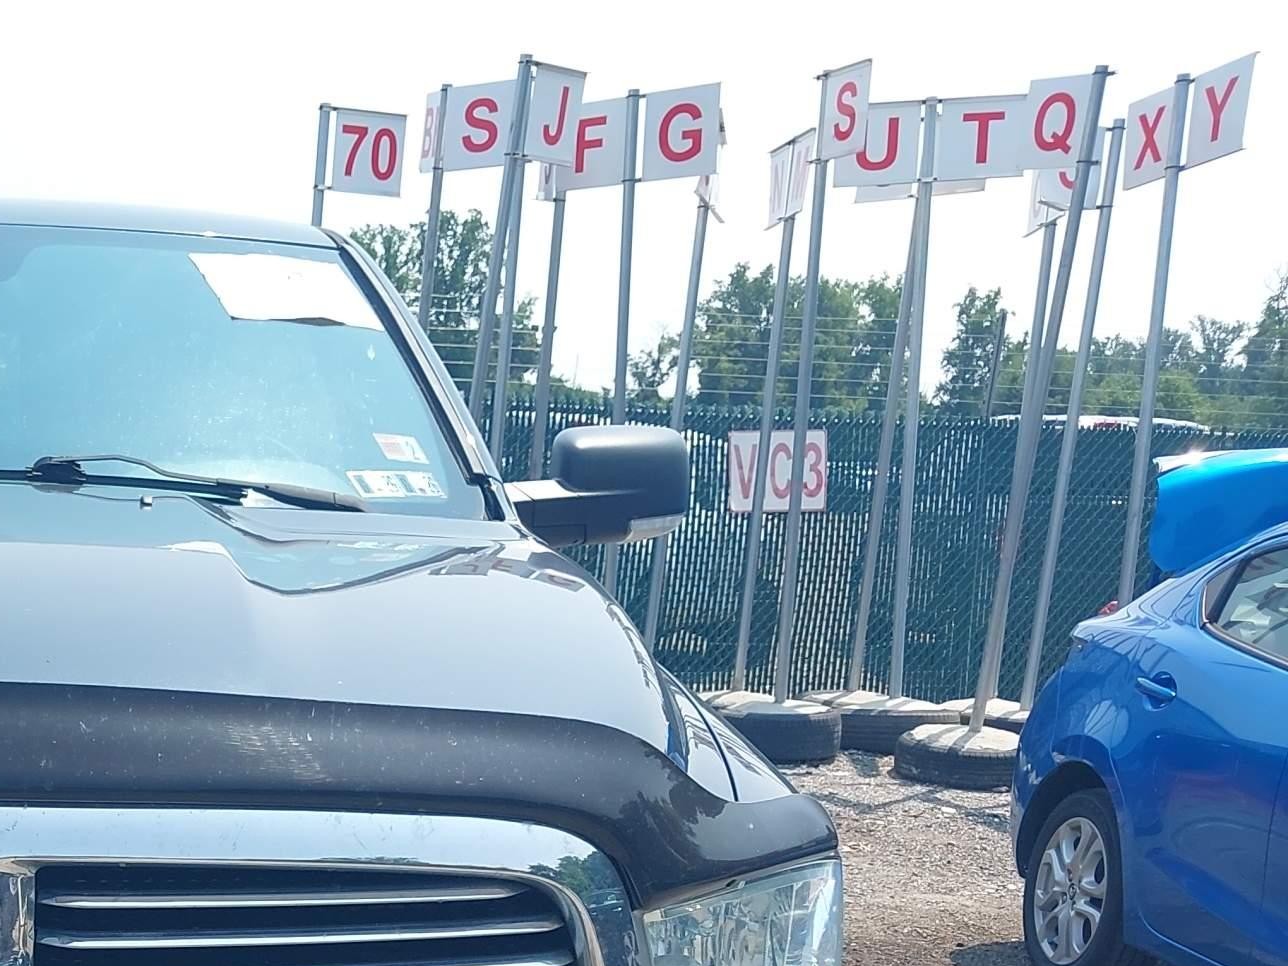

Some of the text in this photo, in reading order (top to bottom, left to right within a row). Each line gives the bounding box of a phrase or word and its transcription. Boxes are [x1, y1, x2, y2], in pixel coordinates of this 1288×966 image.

[462, 97, 499, 154] S
[542, 86, 570, 146] J
[658, 103, 704, 163] G
[832, 81, 859, 142] S
[962, 110, 1006, 165] T
[1033, 92, 1077, 154] Q
[1133, 105, 1166, 171] X
[1205, 75, 1240, 143] Y
[342, 124, 398, 181] 70
[574, 115, 608, 174] F
[733, 442, 824, 500] VC3
